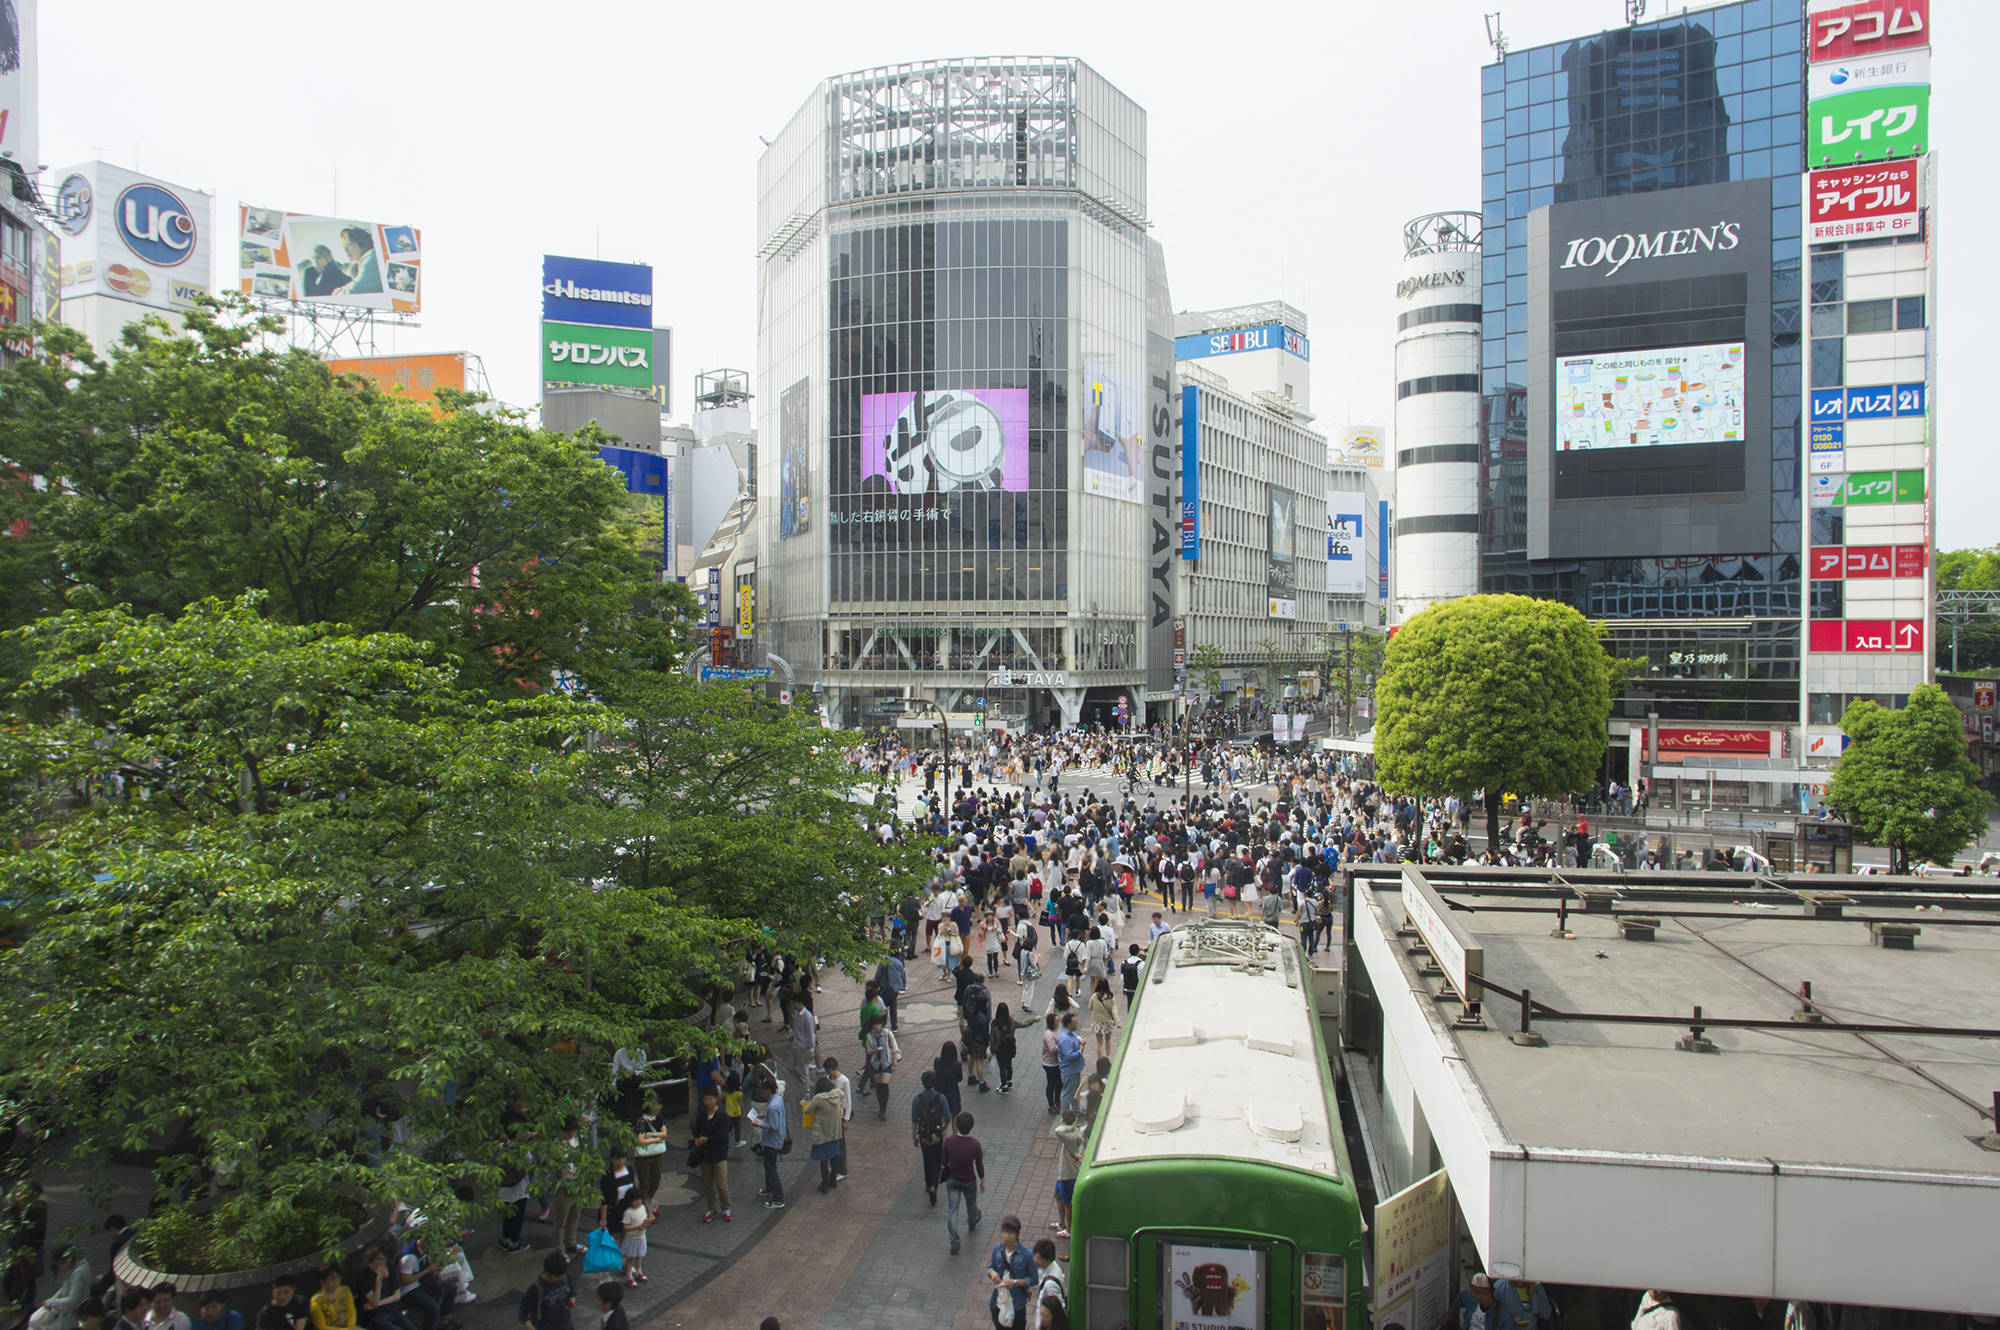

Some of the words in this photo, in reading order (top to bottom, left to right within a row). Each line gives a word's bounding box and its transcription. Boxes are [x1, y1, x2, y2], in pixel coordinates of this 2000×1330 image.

[1817, 7, 1923, 47] アコム
[1854, 61, 1908, 79] 新生銀行
[1821, 104, 1918, 145] レイク
[1816, 171, 1910, 189] キャッシングなら
[1816, 184, 1911, 215] アイフル
[125, 198, 192, 250] UC
[1814, 219, 1886, 238] 新規会員募集中
[1892, 218, 1912, 230] 8F
[1559, 220, 1742, 277] 109MEN'S
[544, 278, 652, 306] Hisamitsu
[1209, 328, 1269, 354] SEIBU
[549, 340, 649, 369] サロンパス
[1812, 433, 1833, 442] 0120
[1819, 461, 1833, 470] 6F
[1152, 370, 1170, 628] TSUTAYA
[1847, 480, 1892, 496] レイク
[1183, 501, 1195, 549] SEIBU
[1819, 553, 1890, 573] アコム
[877, 627, 952, 638] STARBUCKS
[1097, 632, 1137, 647] TSUTAYA
[1856, 636, 1882, 649] 入口
